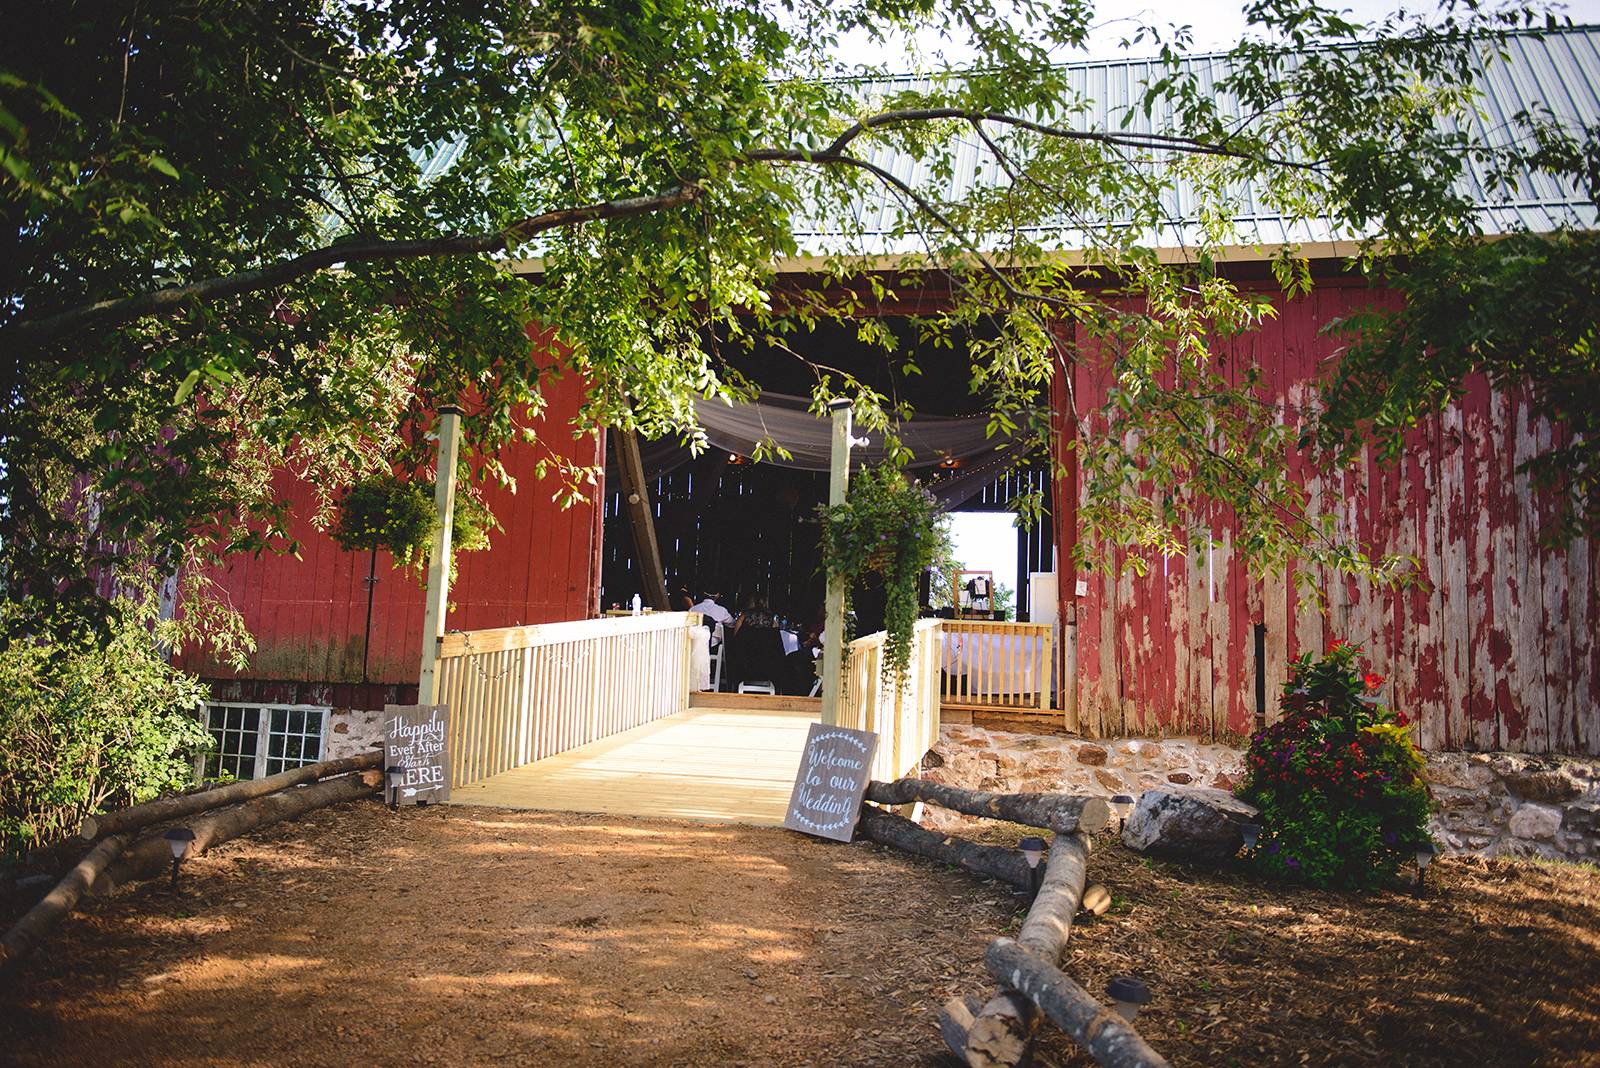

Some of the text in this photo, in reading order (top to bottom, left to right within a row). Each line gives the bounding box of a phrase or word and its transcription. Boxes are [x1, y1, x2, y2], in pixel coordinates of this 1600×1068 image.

[385, 710, 444, 746] Happily
[389, 741, 444, 757] Ever After
[807, 744, 864, 770] Welcome
[391, 765, 444, 787] ERE
[805, 766, 857, 792] to our
[798, 782, 852, 816] Wedding
